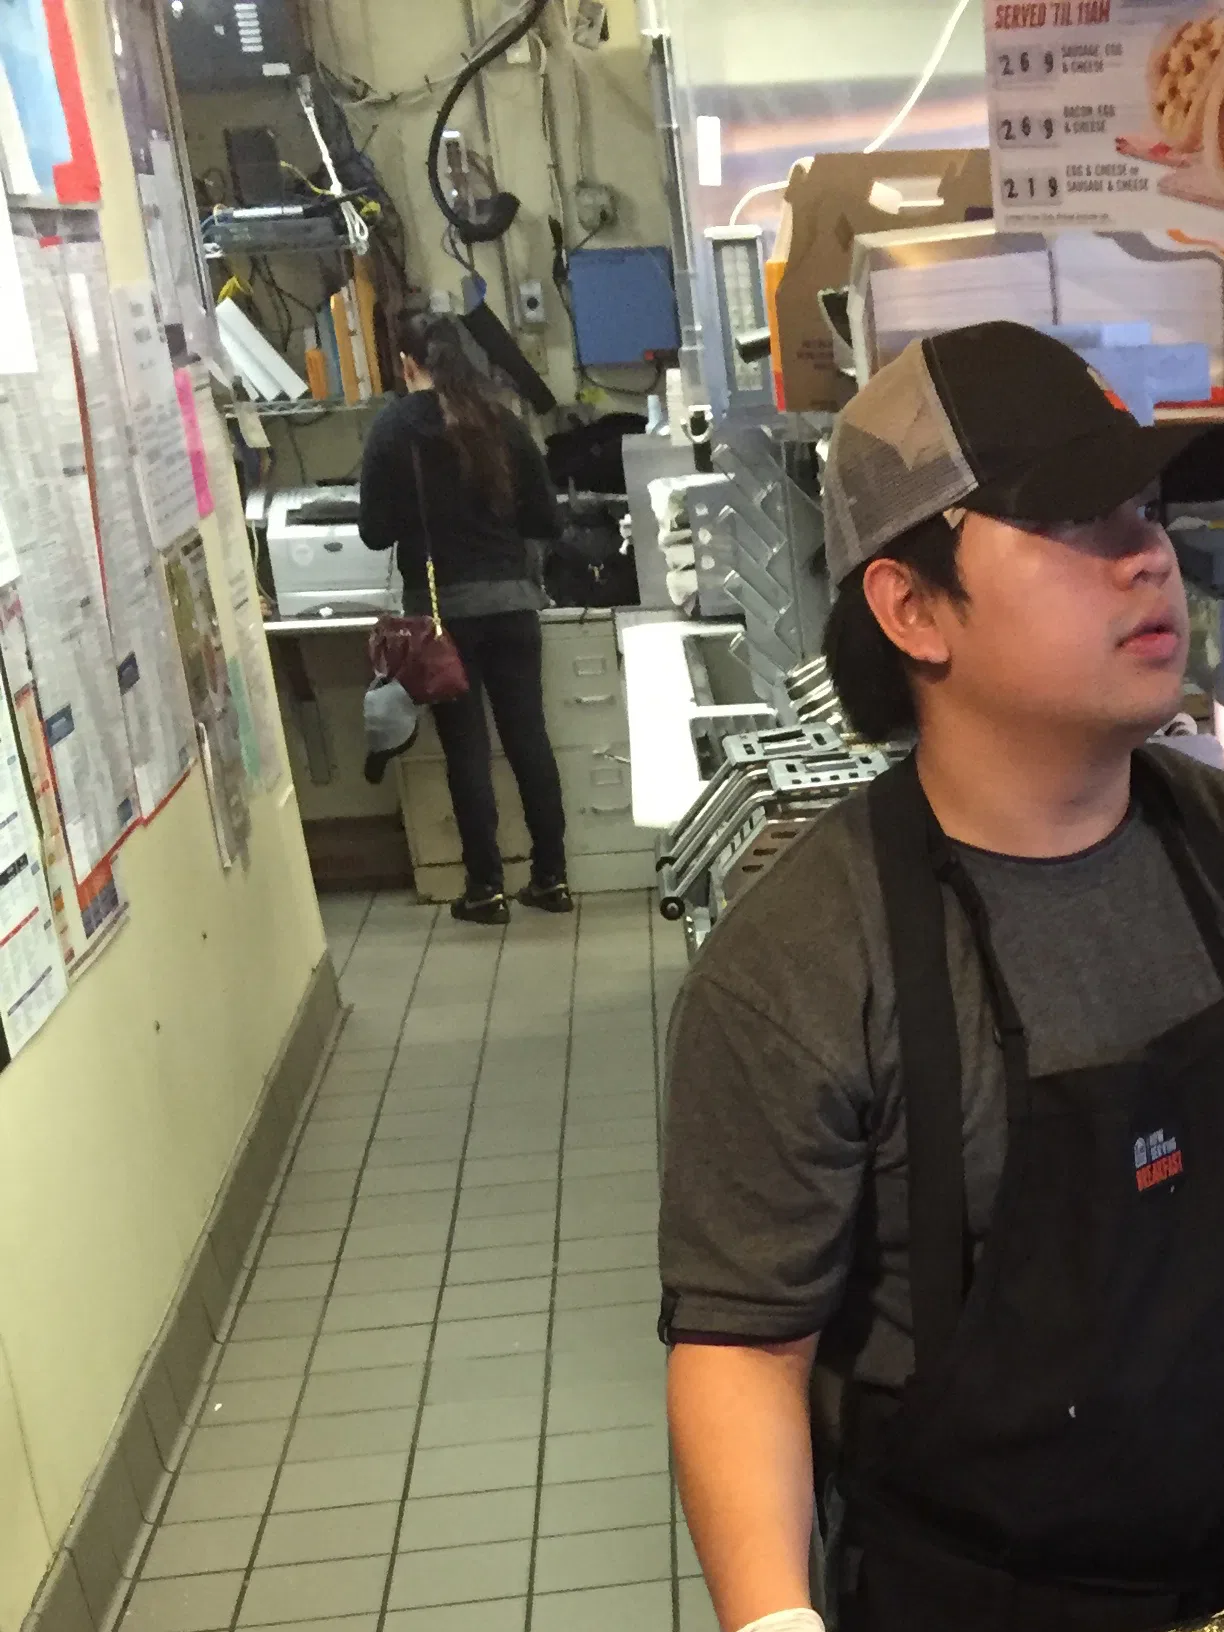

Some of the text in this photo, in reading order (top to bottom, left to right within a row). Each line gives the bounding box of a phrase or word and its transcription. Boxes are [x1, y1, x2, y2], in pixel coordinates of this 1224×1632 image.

[995, 2, 1047, 29] SERVED
[1077, 0, 1110, 25] 11AM
[1094, 163, 1128, 177] CHEESE
[1066, 178, 1150, 193] SAUSAGE & CHEESE
